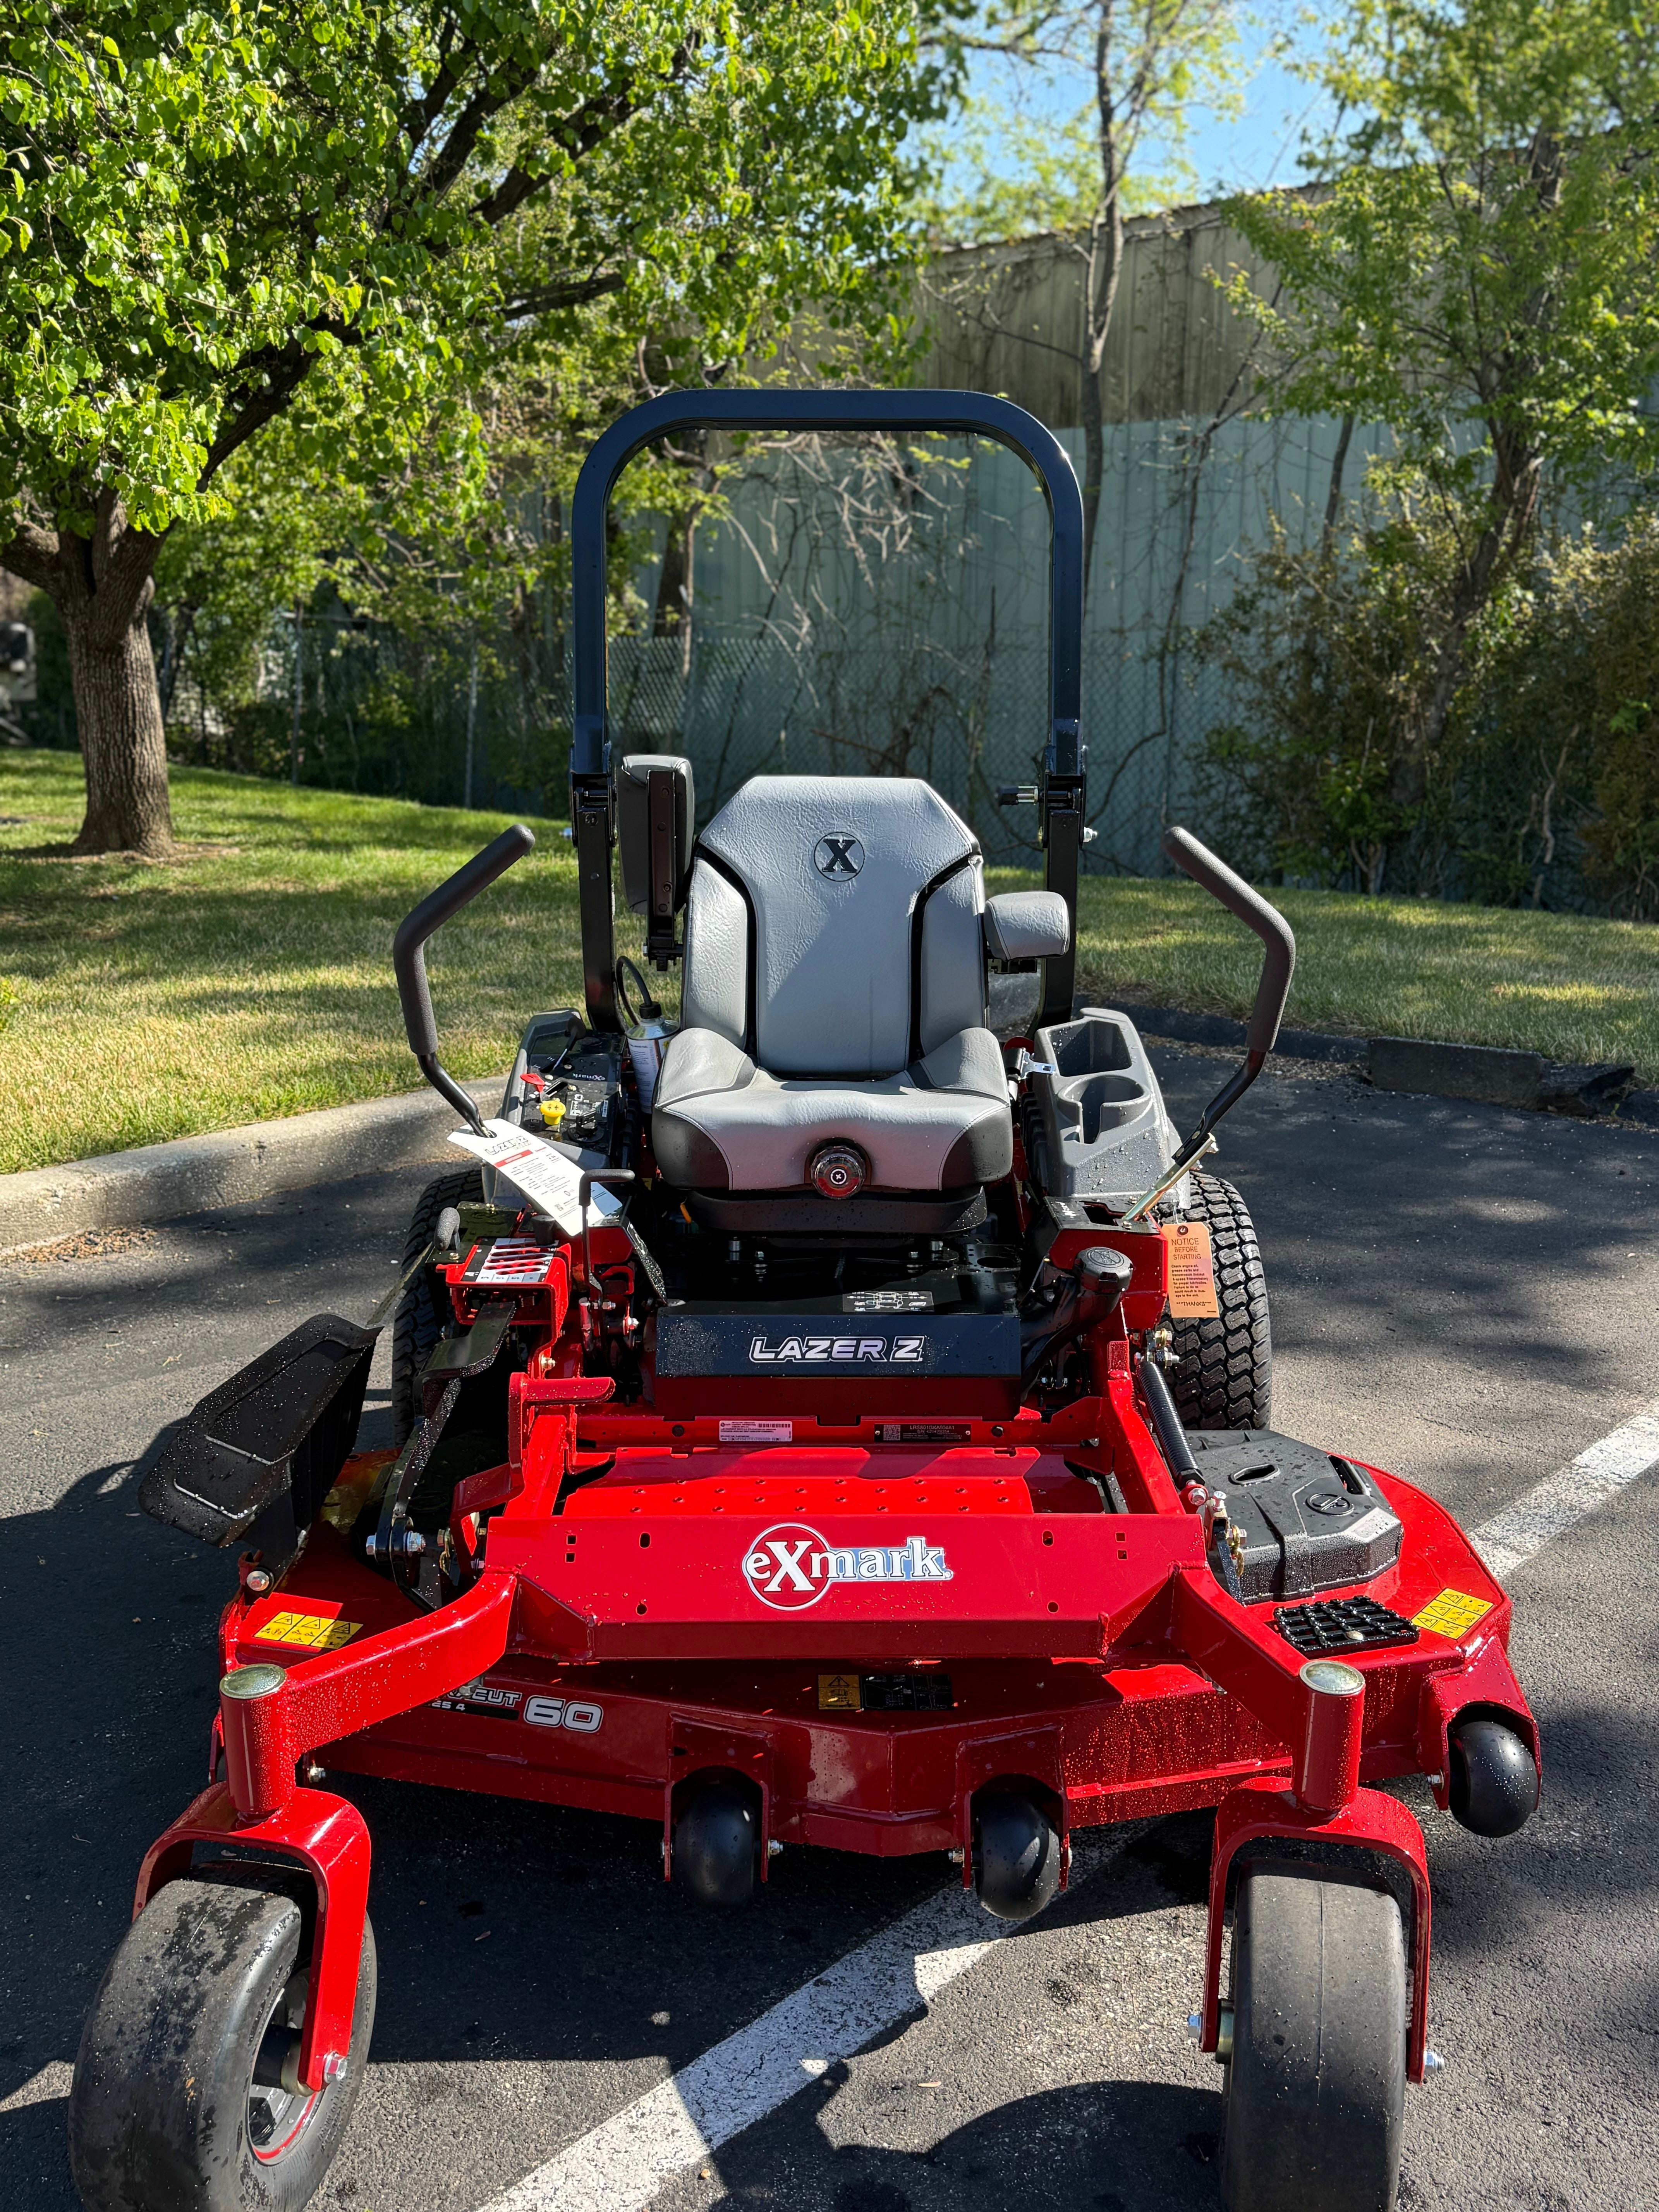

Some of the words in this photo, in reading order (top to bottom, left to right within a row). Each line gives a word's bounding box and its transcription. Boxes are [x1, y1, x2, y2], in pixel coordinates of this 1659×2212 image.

[822, 839, 857, 873] X
[1171, 1238, 1199, 1246] NOTICE
[749, 1336, 887, 1362] LAZER
[890, 1336, 925, 1362] Z
[746, 1539, 944, 1592] eXmark
[524, 1695, 604, 1733] 60
